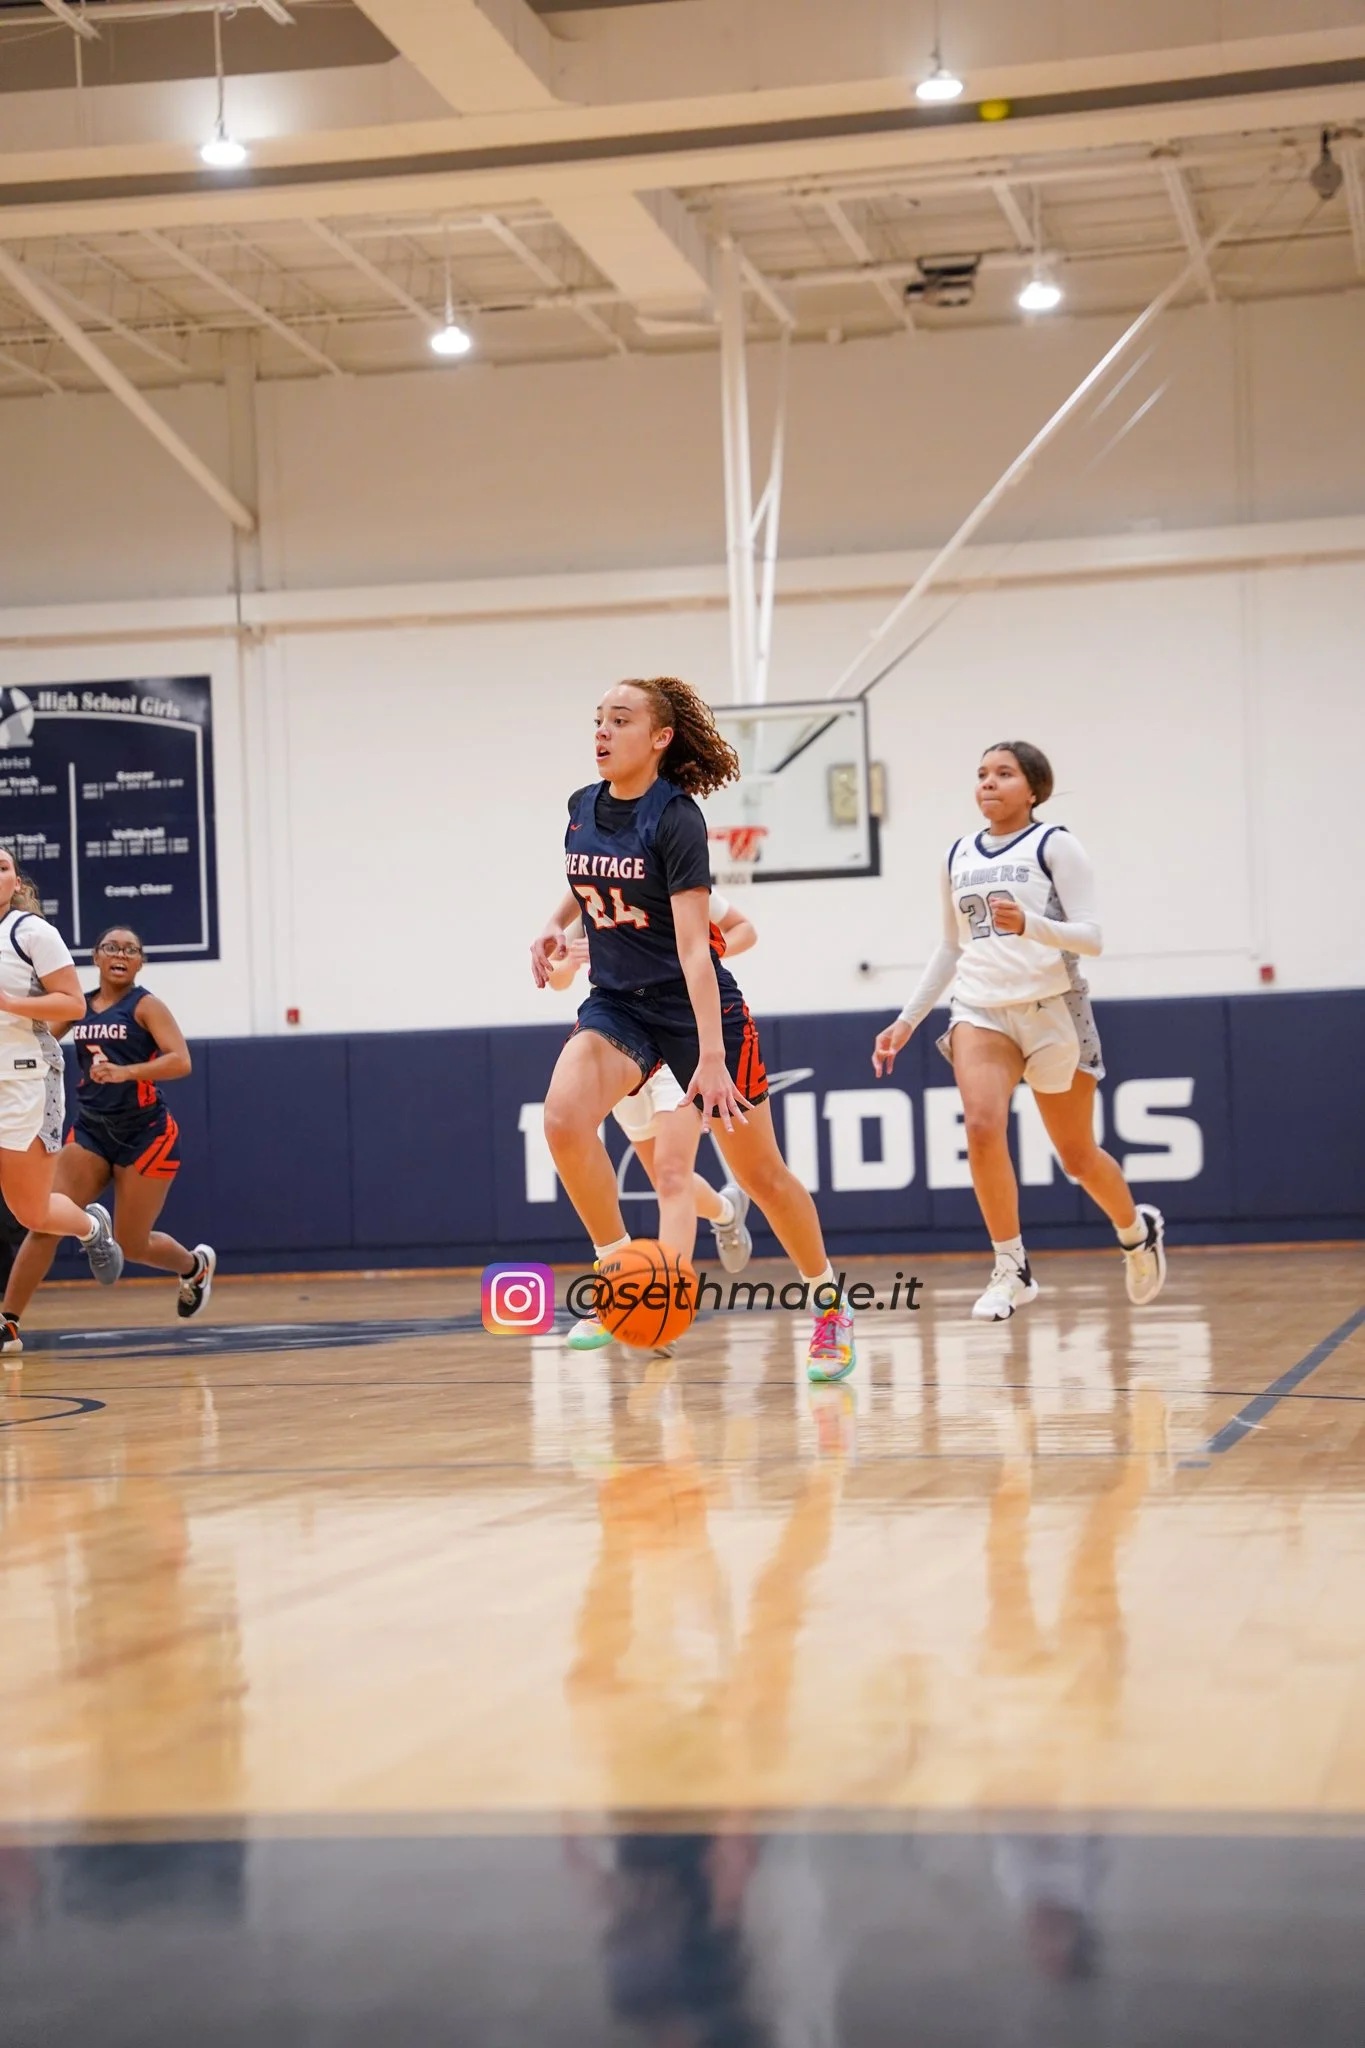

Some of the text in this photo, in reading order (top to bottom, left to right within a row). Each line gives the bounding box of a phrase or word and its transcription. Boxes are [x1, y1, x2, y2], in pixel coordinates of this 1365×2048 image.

[38, 691, 181, 718] High School Girls
[573, 884, 650, 930] 24
[73, 1024, 128, 1040] ERITAGE
